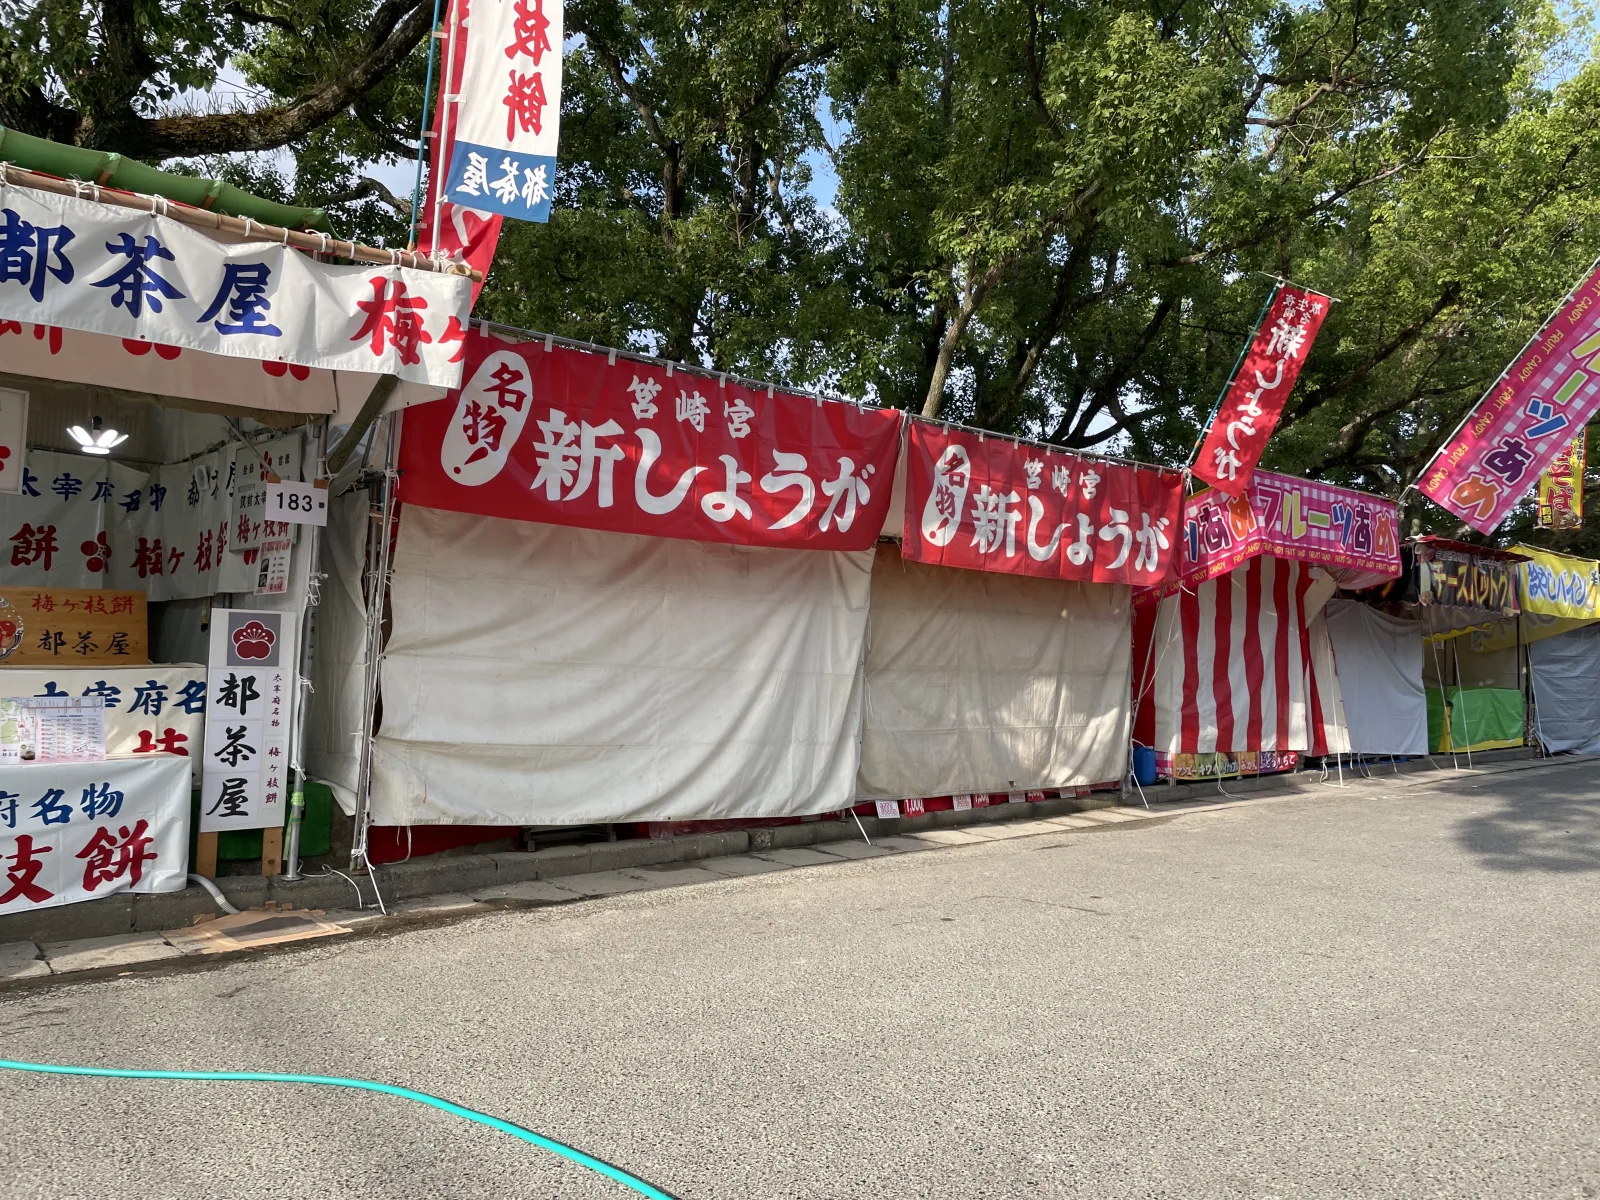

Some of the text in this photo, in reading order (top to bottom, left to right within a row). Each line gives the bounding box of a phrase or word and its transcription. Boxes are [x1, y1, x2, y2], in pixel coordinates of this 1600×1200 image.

[0, 208, 283, 337] 都茶屋
[1425, 296, 1592, 493] CANDY FRUIT CANDY FRUIT CANDY FRUIT CANDY
[276, 492, 313, 512] 183
[530, 408, 876, 533] 新しょうが
[970, 484, 1170, 573] 新しょうが
[1256, 485, 1397, 560] フルーツあめ
[1192, 570, 1207, 581] FRUIT
[1210, 562, 1226, 574] CANDY
[37, 629, 130, 655] 都茶屋
[206, 672, 260, 818] 都茶屋
